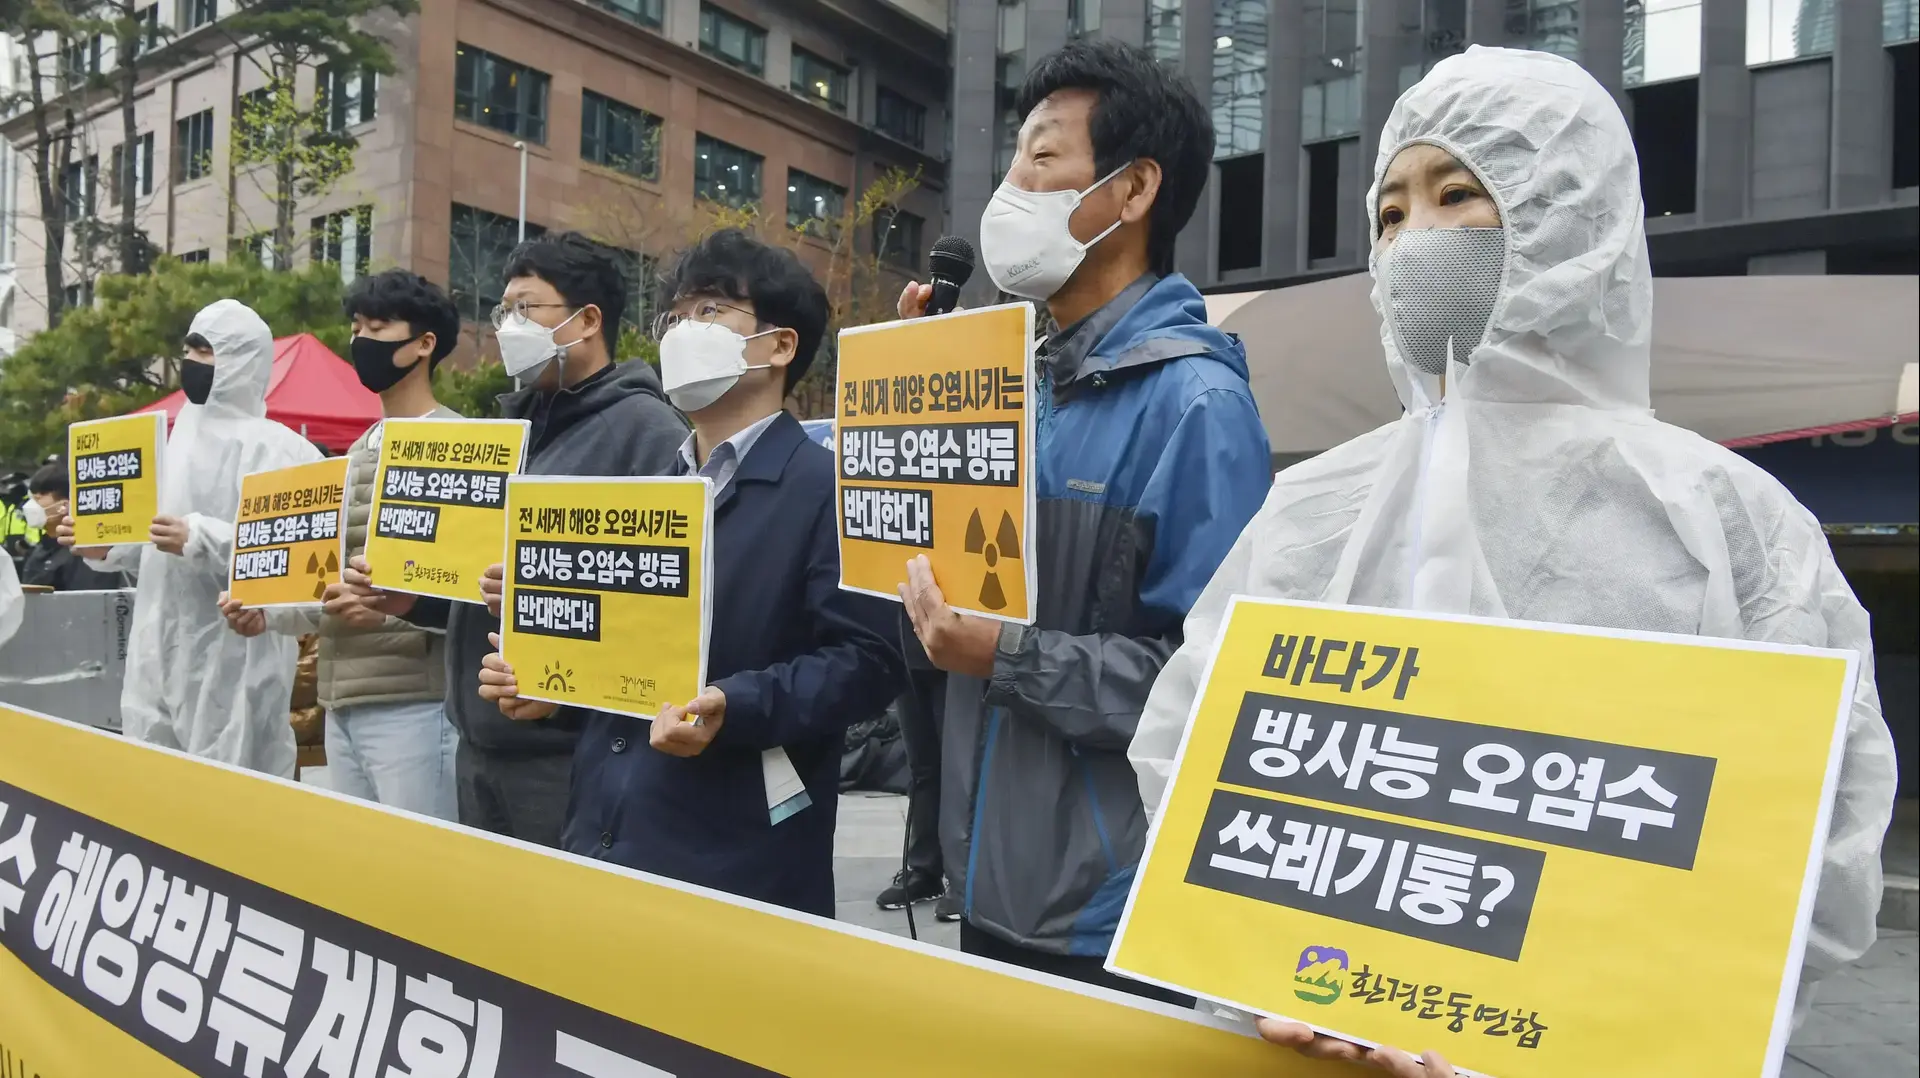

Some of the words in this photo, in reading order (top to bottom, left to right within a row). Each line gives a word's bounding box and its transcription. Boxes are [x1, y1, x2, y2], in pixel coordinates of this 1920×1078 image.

[844, 381, 857, 417] 전
[860, 377, 889, 415] 세계
[892, 373, 925, 414] 해양
[928, 366, 1024, 412] 오염시키는
[76, 432, 99, 450] 바다가
[390, 440, 401, 460] 전
[401, 440, 425, 461] 세계
[425, 441, 449, 462] 해양
[450, 442, 511, 466] 오염시키는
[842, 430, 896, 477] 방사능
[899, 429, 961, 479] 오염수
[966, 427, 1015, 481] 방류
[77, 456, 106, 480] 방사능
[107, 452, 139, 476] 오염수
[78, 487, 121, 511] 쓰레기통?
[242, 498, 250, 516] 전
[252, 494, 271, 514] 세계
[272, 491, 292, 512] 해양
[292, 483, 344, 509] 오염시키는
[386, 469, 425, 497] 방사능
[425, 472, 468, 501] 오염수
[470, 475, 501, 503] 방류
[238, 521, 272, 548] 방사능
[272, 515, 309, 543] 오염수
[311, 511, 338, 539] 방류
[379, 507, 435, 537] 반대한다!
[519, 507, 533, 533] 전
[536, 507, 566, 534] 세계
[569, 508, 600, 536] 해양
[603, 509, 688, 538] 오염시키는
[844, 489, 930, 544] 반대한다!
[234, 549, 288, 580] 반대한다!
[520, 546, 573, 581] 방사능
[576, 549, 634, 586] 오염수
[638, 552, 681, 588] 방류
[517, 595, 594, 633] 반대한다!
[1260, 633, 1420, 700] 바다가
[620, 675, 656, 697] 감시센터
[1248, 708, 1439, 800] 방사능
[1449, 742, 1678, 841] 오염수
[0, 803, 37, 931] 수
[1209, 809, 1515, 929] 쓰레기통?
[1349, 964, 1548, 1049] 환경운동연합
